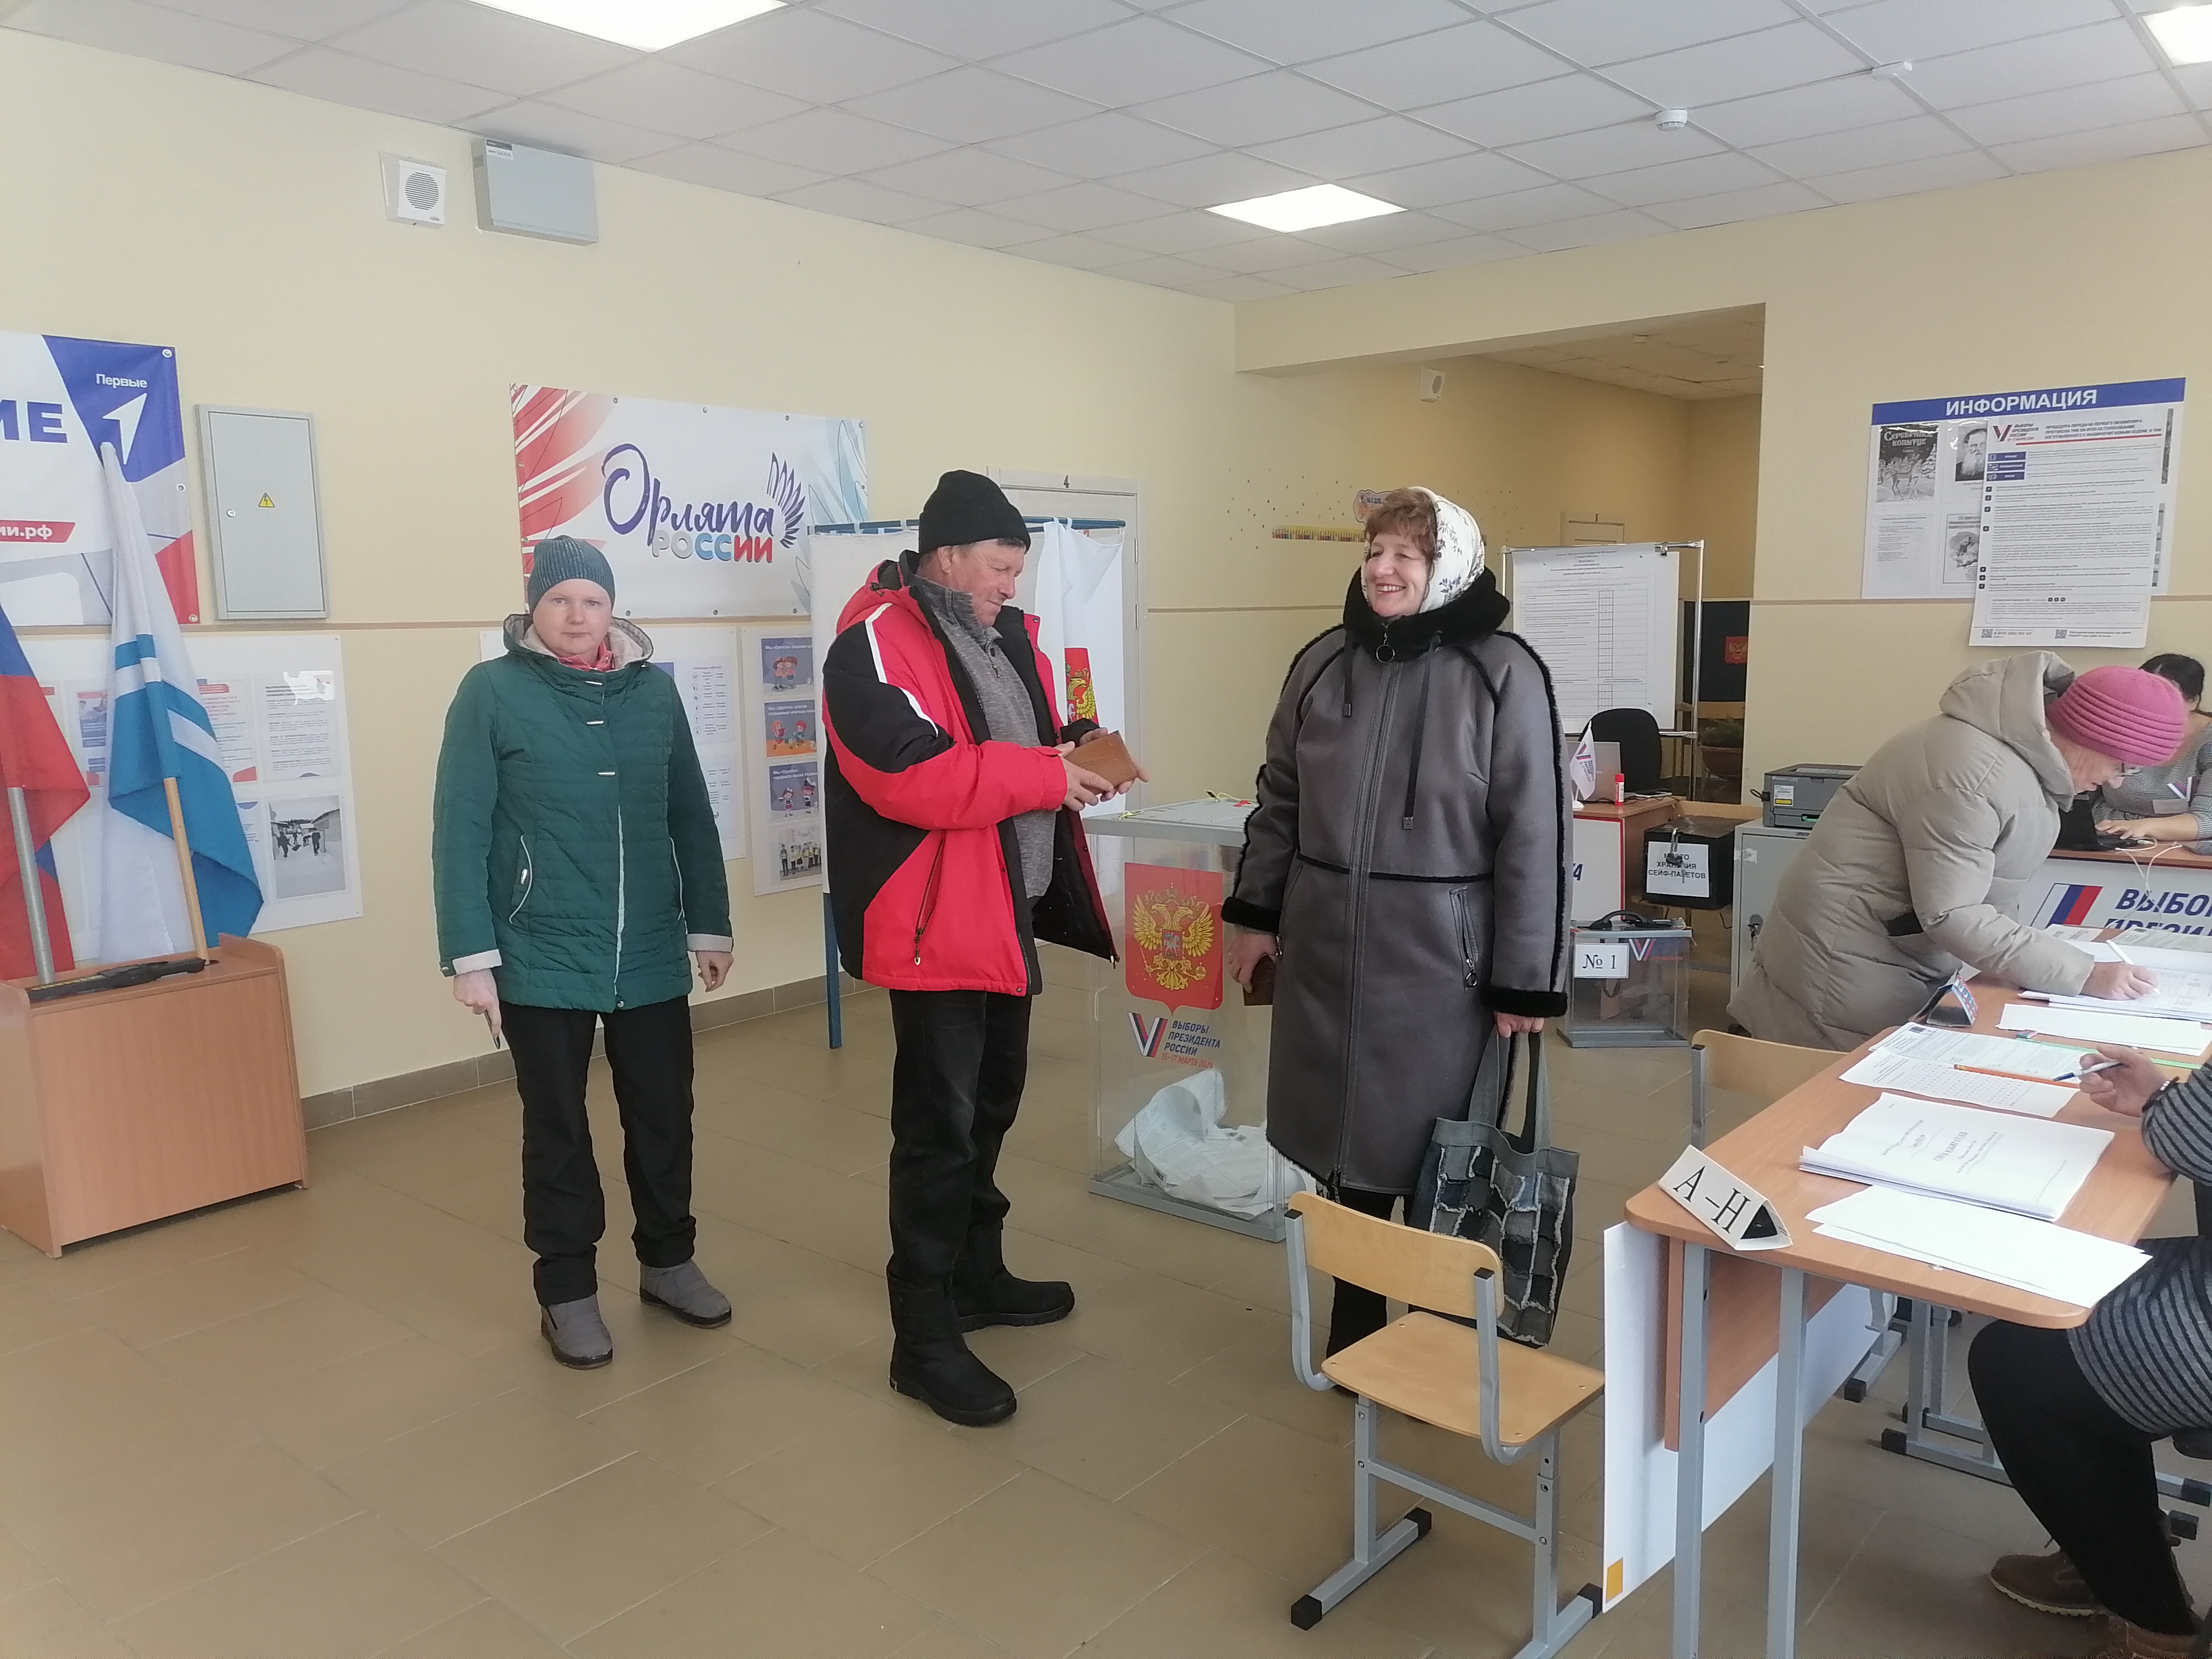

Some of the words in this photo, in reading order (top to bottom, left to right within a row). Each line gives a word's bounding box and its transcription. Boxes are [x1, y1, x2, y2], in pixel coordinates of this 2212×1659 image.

[96, 373, 148, 389] Первые
[1945, 389, 2098, 416] ИНФОРМАЦИЯ
[1063, 474, 1070, 488] 4
[601, 443, 774, 546] Орлята
[653, 529, 773, 563] РОССИИ
[1648, 869, 1706, 879] СЕЙФ-ПАЕТОВ
[2115, 889, 2212, 917] ВЫБО
[1610, 954, 1616, 969] 1
[1172, 1020, 1209, 1034] ВЫБОРЫ
[1168, 1031, 1220, 1048] ПРЕЗИДЕНТА
[1164, 1042, 1198, 1056] РОССИИ
[1177, 1057, 1198, 1066] МАРТА
